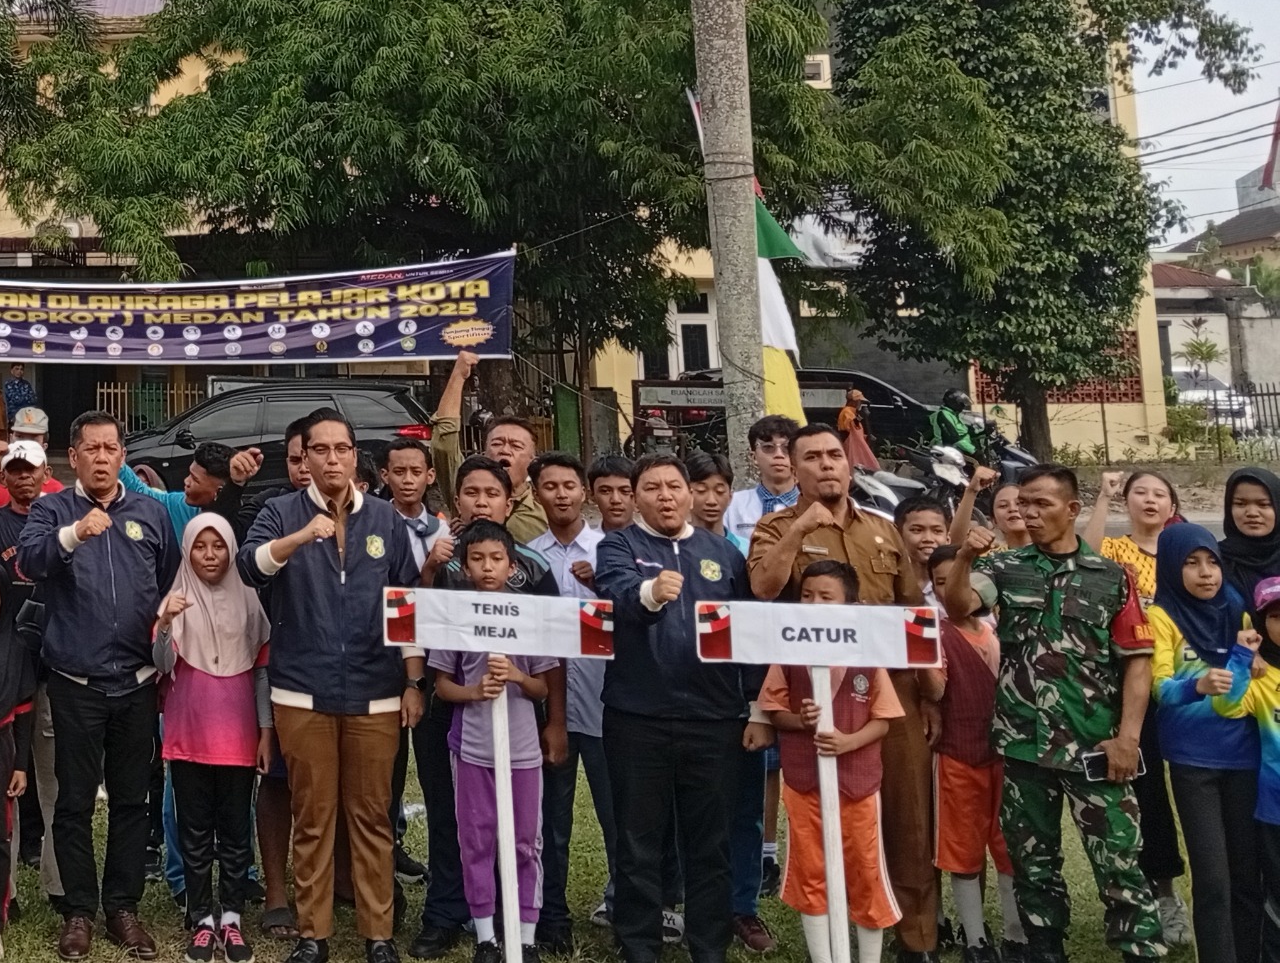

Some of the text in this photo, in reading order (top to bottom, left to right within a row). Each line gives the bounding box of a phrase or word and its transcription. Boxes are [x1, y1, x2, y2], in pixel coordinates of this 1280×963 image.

[47, 293, 230, 311] OLAHRAGA
[235, 287, 391, 309] PELAJAR
[396, 279, 491, 302] KOTA
[143, 310, 266, 325] MEDAN
[273, 305, 391, 323] TAHUN
[398, 301, 478, 319] 2025
[471, 602, 520, 617] TENIS
[473, 625, 518, 639] MEJA
[780, 626, 858, 644] CATUR
